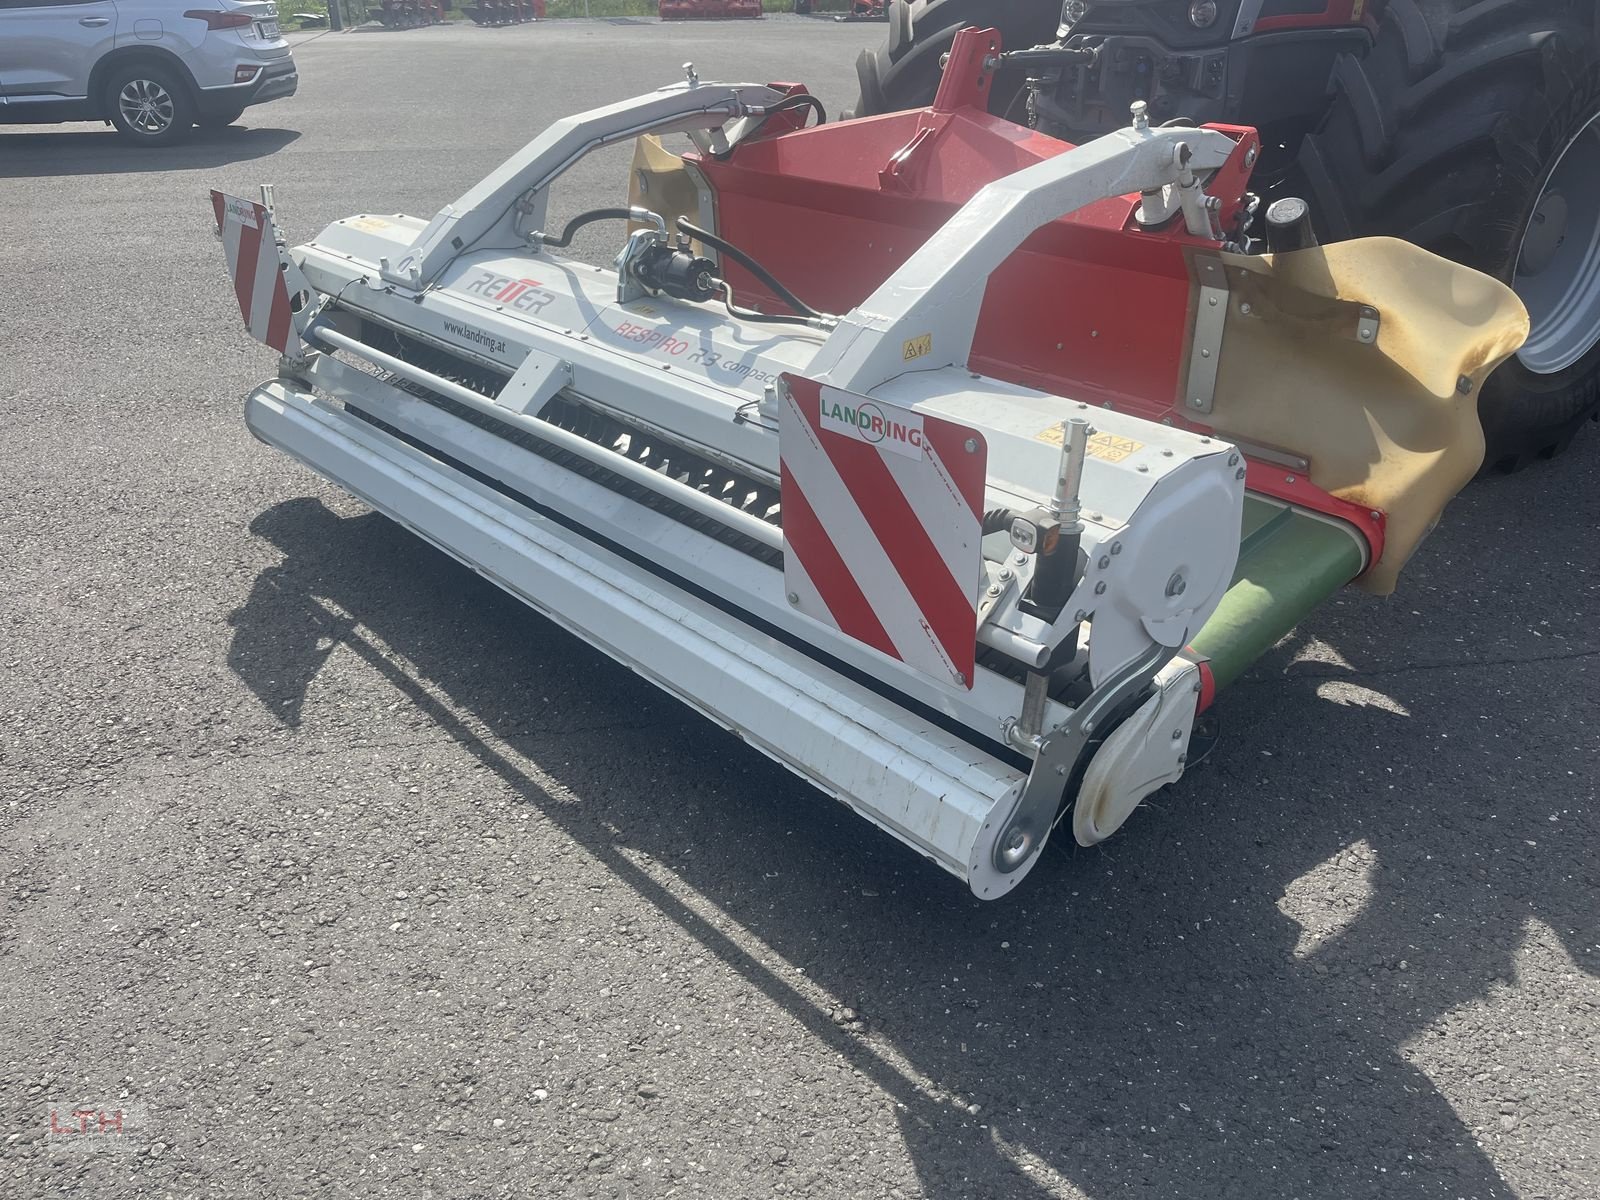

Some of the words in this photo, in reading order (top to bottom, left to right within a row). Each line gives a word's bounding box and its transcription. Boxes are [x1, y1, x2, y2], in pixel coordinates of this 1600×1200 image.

[443, 320, 506, 353] www.landring.at
[612, 320, 689, 356] RESPIRO
[686, 347, 723, 367] R3
[821, 399, 921, 448] LANDRING
